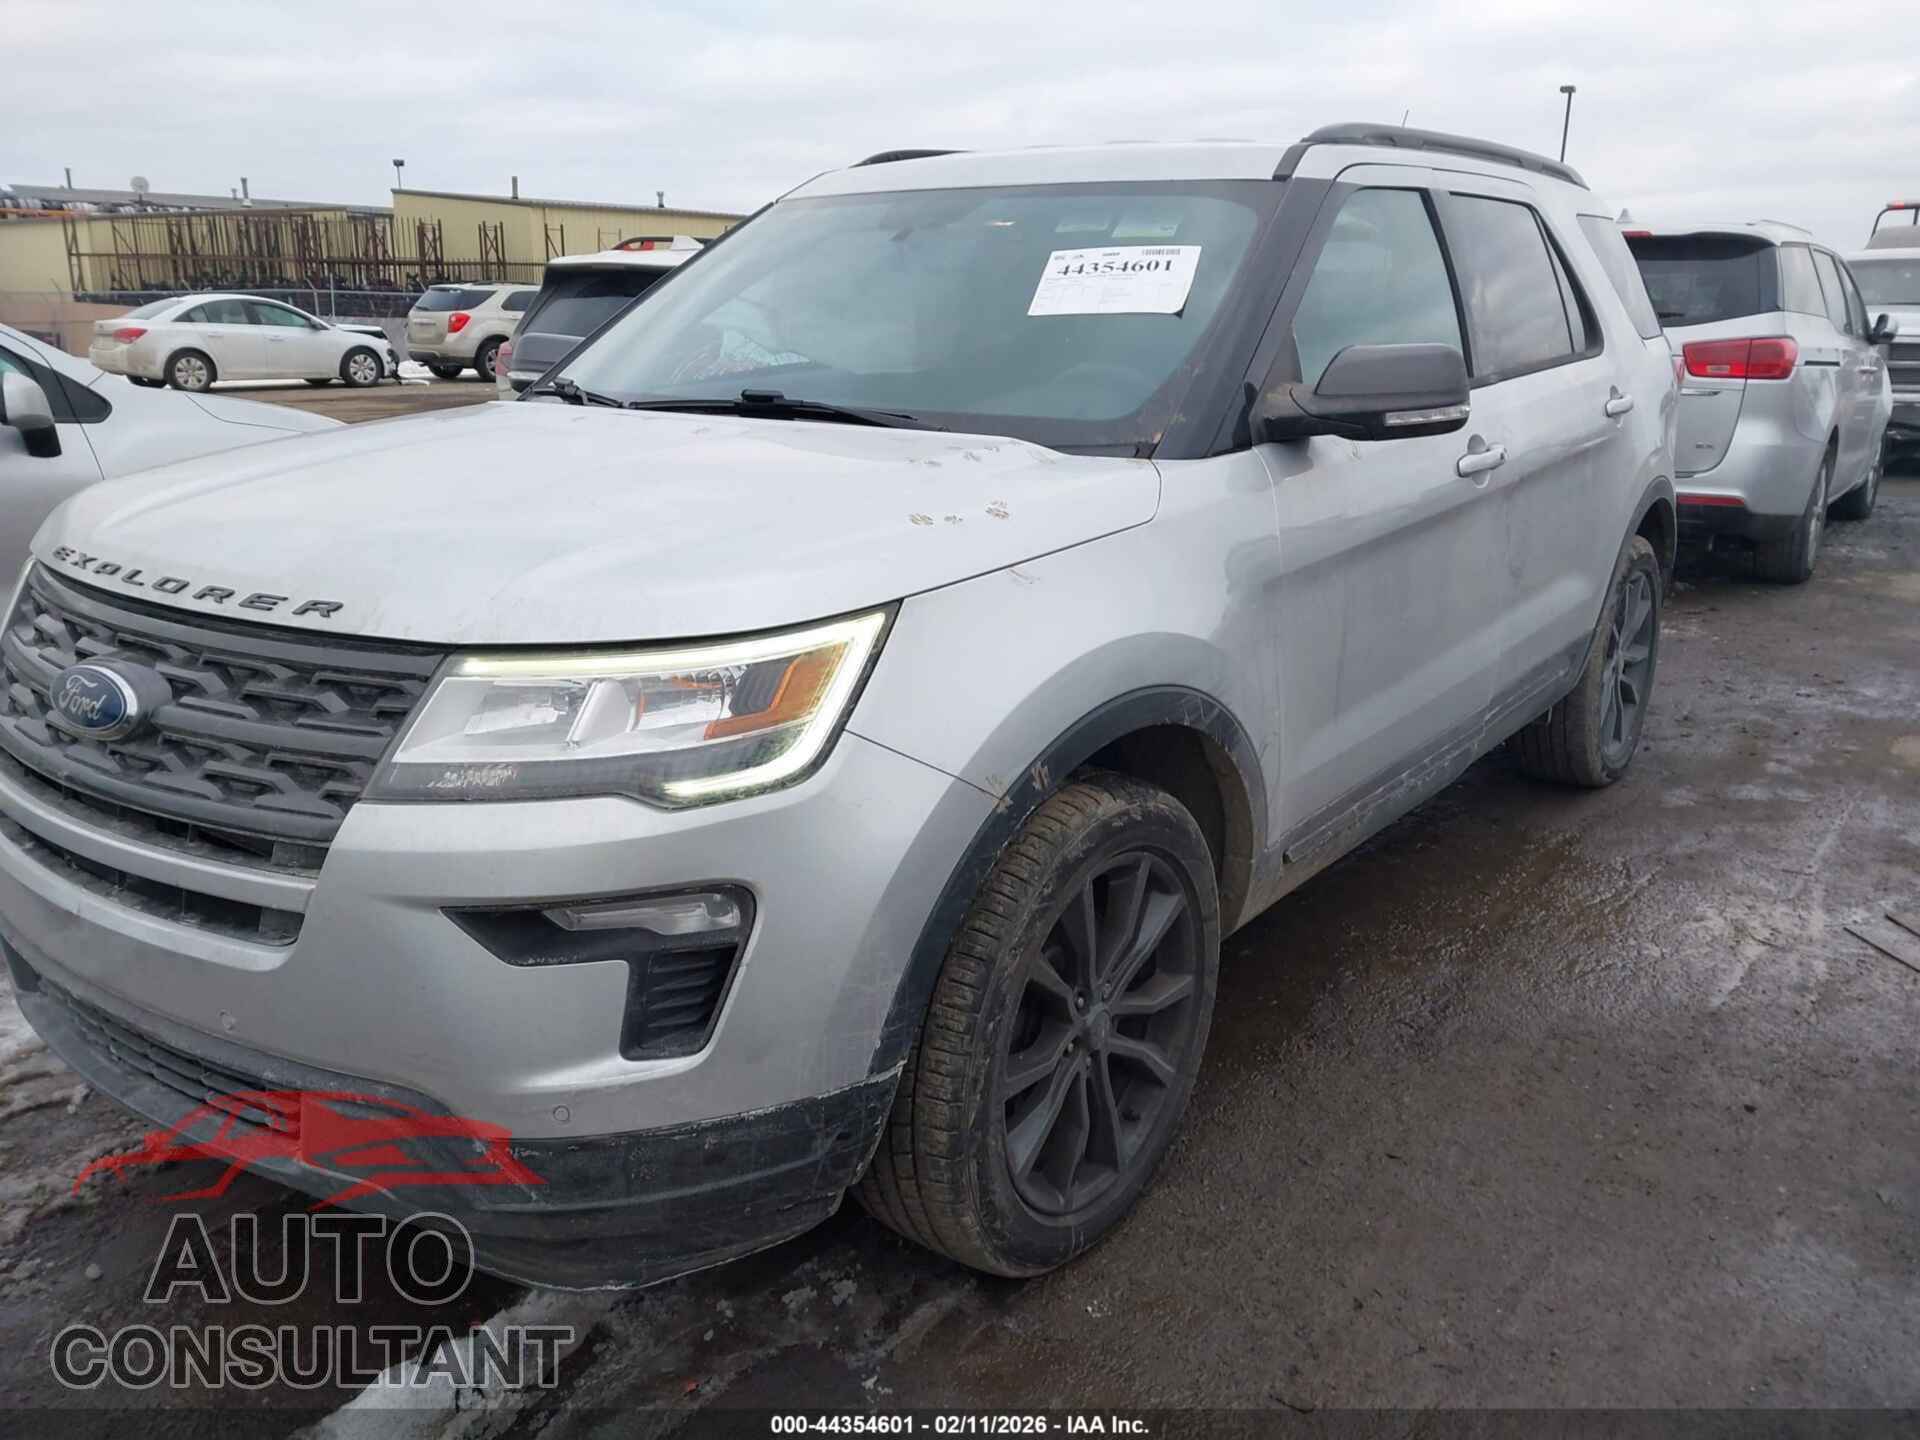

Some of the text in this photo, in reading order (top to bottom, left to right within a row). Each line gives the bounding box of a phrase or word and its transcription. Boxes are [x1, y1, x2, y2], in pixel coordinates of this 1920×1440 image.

[1057, 259, 1173, 276] 44354601
[52, 545, 345, 619] EXPLORER
[58, 674, 108, 720] Ford
